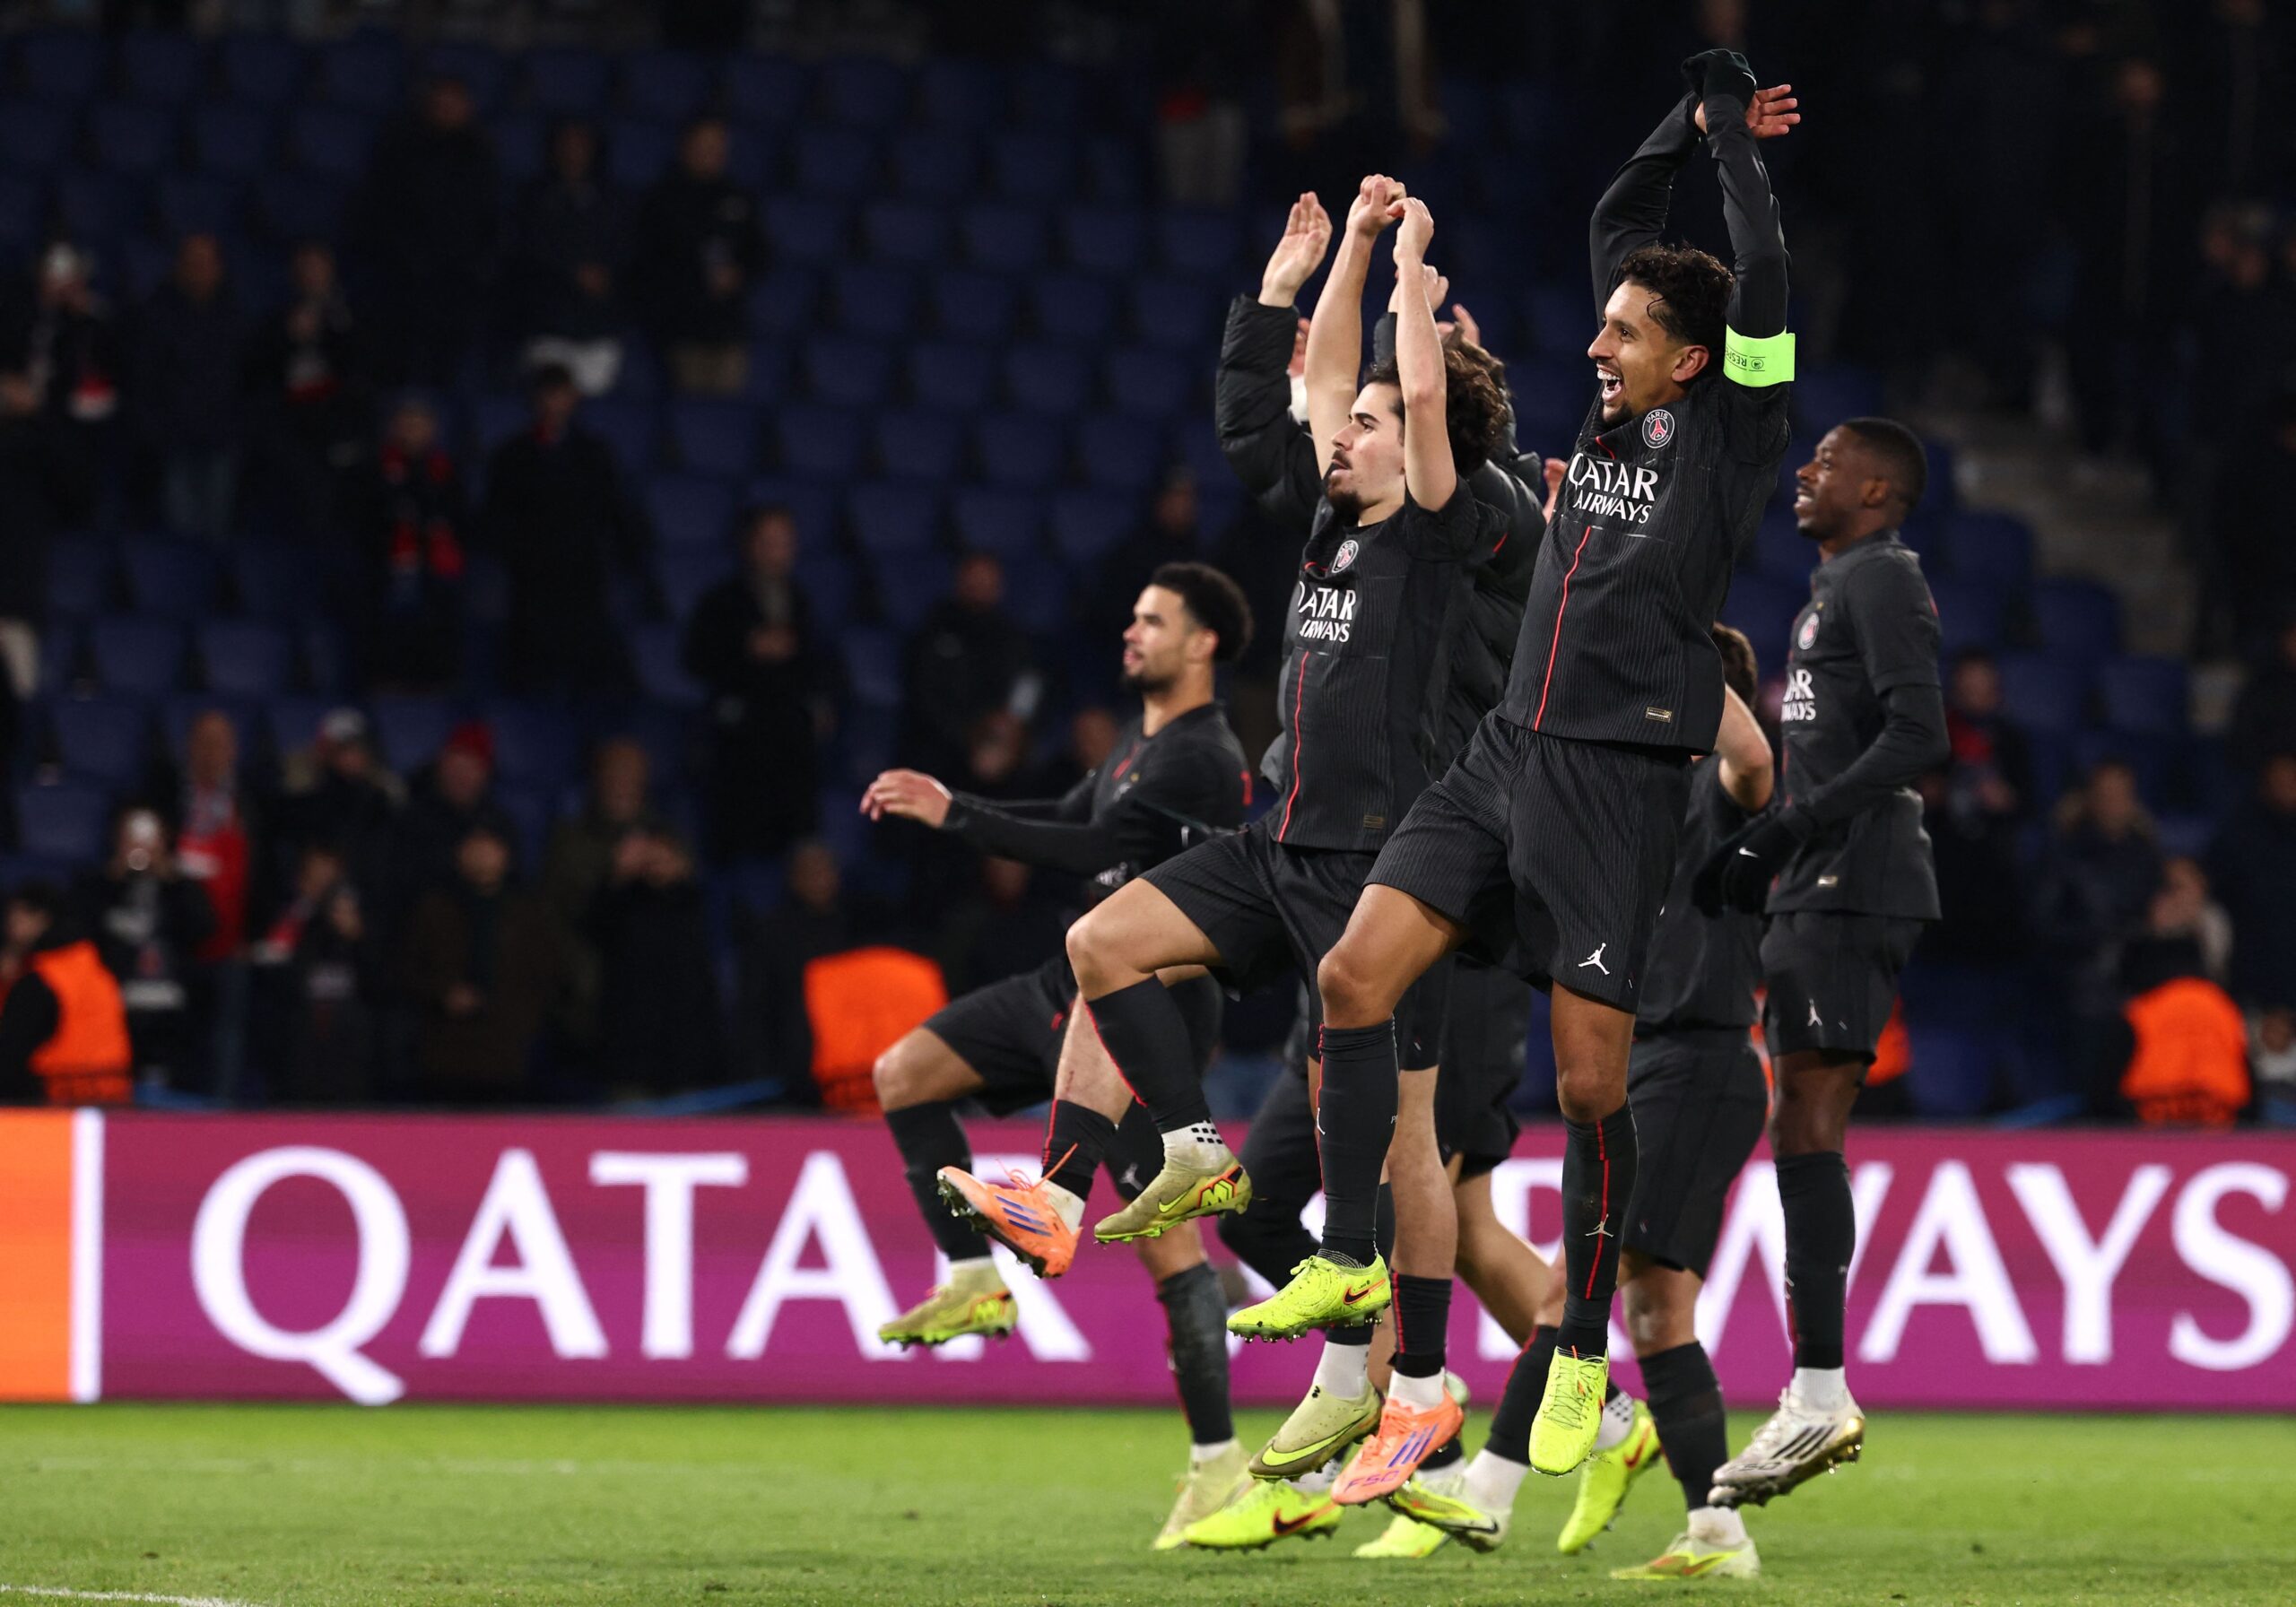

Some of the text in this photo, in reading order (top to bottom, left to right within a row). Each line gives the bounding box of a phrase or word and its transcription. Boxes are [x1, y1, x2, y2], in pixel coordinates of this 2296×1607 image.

[1646, 411, 1669, 424] PARIS
[1572, 489, 1653, 524] AIRWAYS
[1299, 619, 1351, 643] IRWAYS
